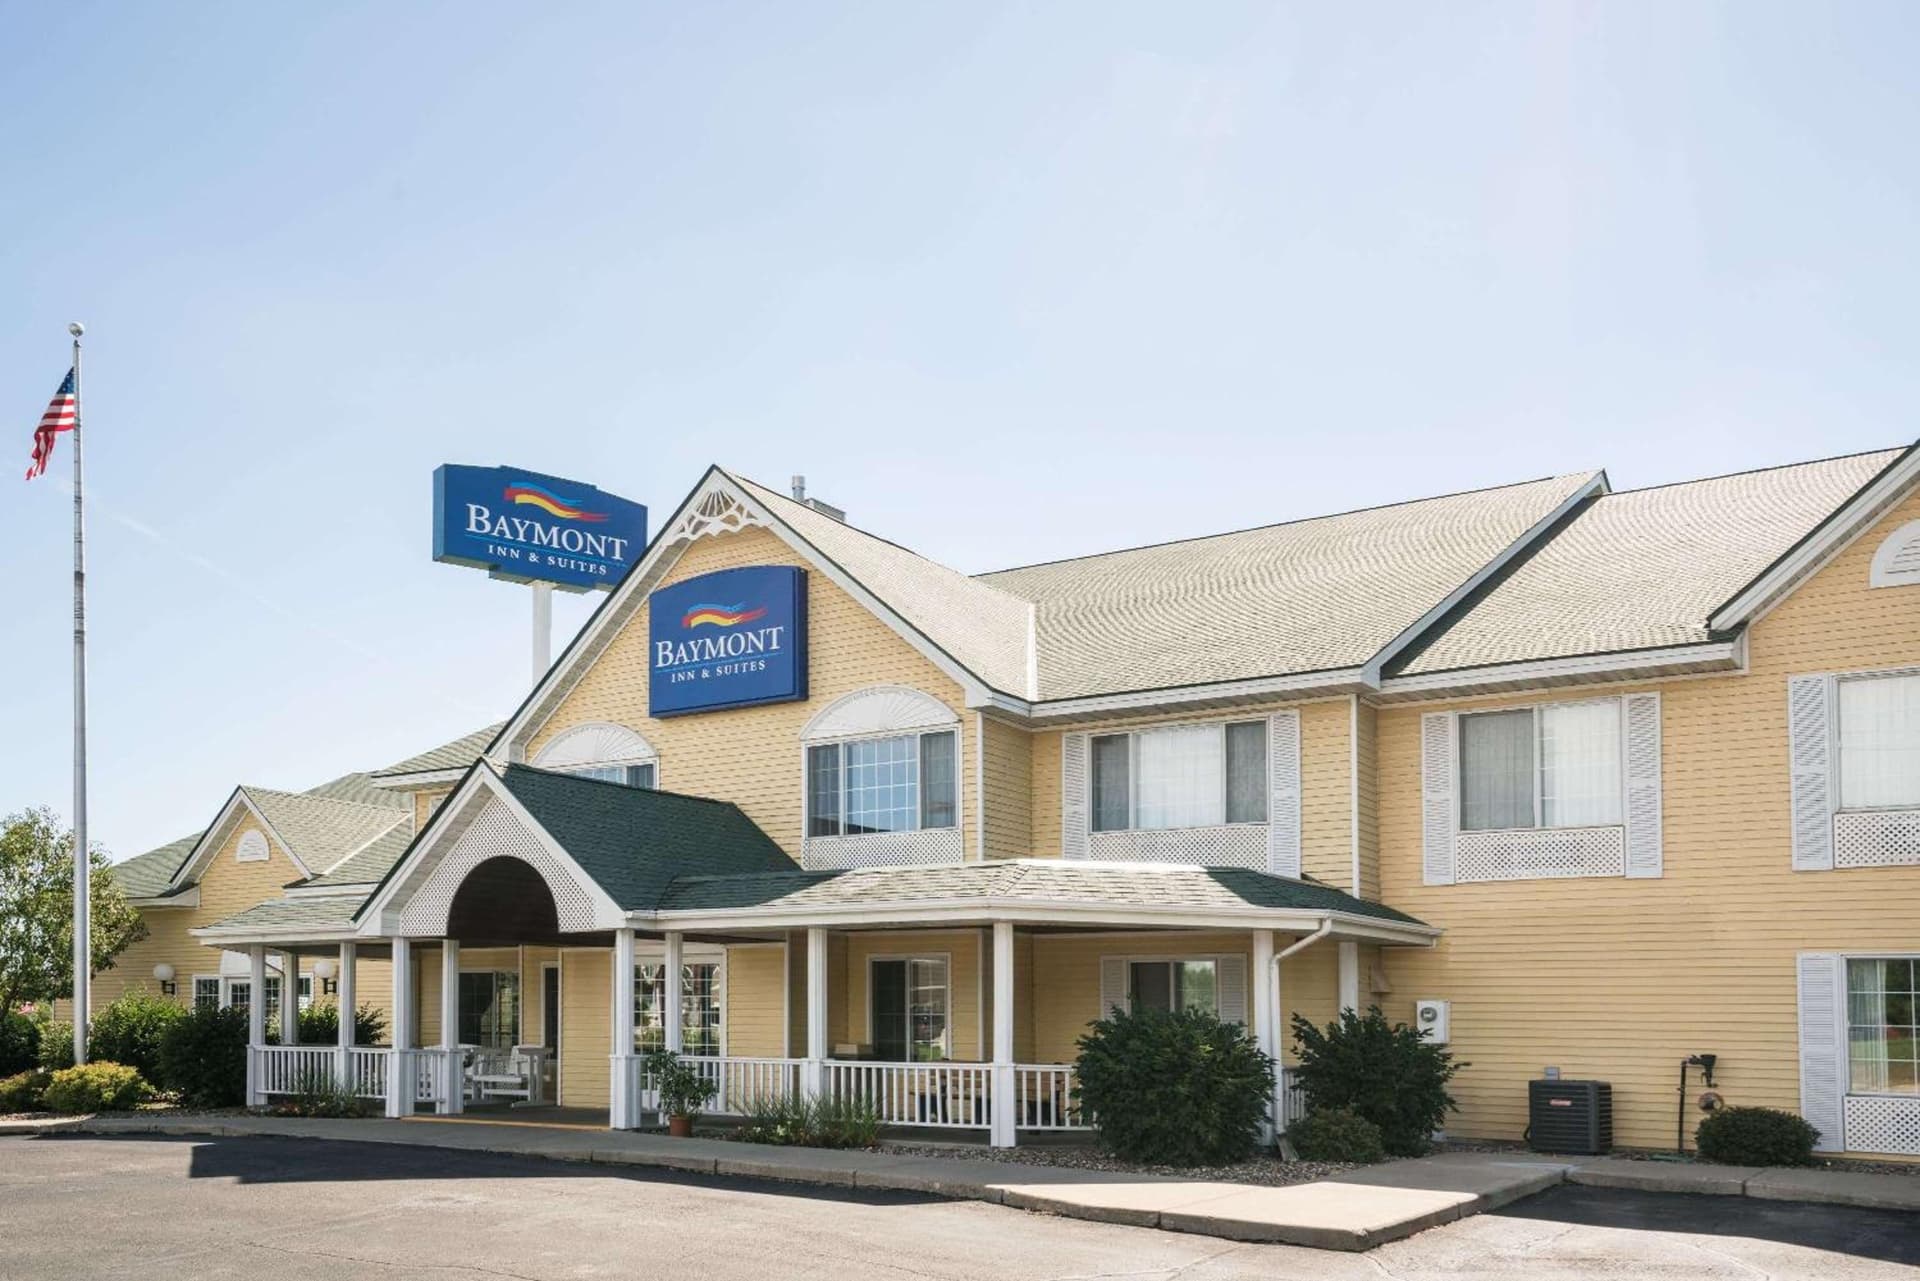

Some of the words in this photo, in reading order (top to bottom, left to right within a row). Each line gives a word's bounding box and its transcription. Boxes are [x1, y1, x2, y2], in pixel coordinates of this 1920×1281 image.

[465, 503, 628, 561] BAYMONT
[488, 544, 520, 559] INN
[529, 552, 540, 563] &
[547, 556, 607, 575] SUITES
[655, 626, 784, 668] BAYMONT
[671, 670, 695, 683] INN
[701, 668, 710, 679] &
[716, 660, 766, 676] SUITES
